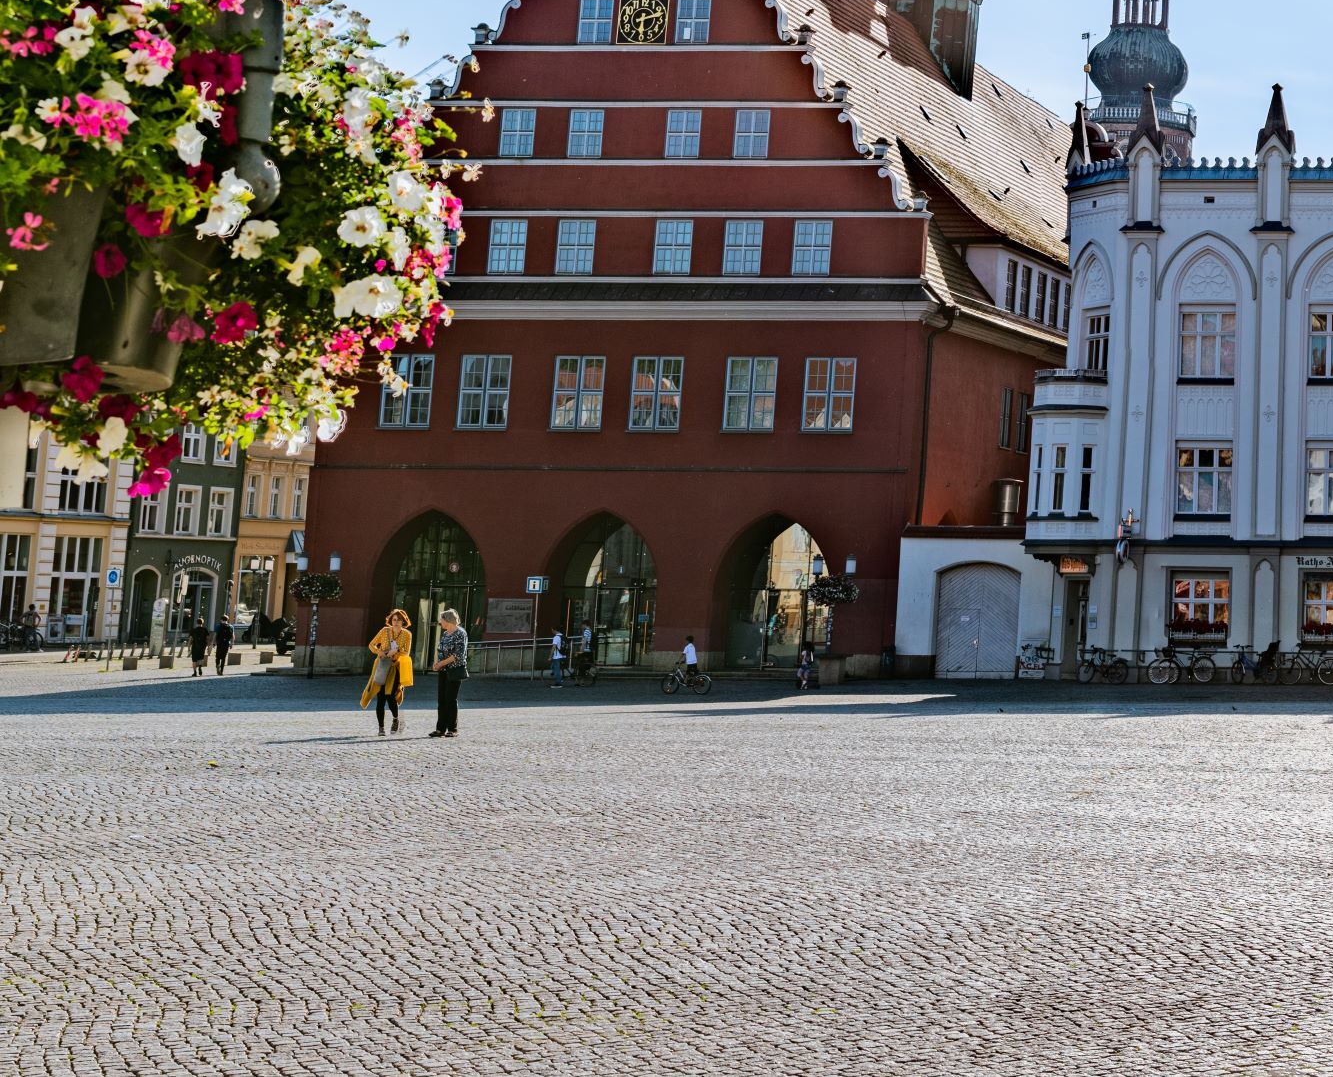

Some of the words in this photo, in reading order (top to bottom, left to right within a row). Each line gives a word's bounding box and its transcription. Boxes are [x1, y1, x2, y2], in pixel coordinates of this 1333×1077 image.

[633, 0, 639, 9] 11
[651, 0, 656, 9] 1
[624, 6, 633, 15] 10
[623, 15, 629, 23] 9
[624, 24, 630, 32] 8
[654, 24, 659, 32] 4
[630, 30, 636, 38] 7
[647, 30, 653, 39] 5
[174, 554, 222, 571] AUGENOPTIK
